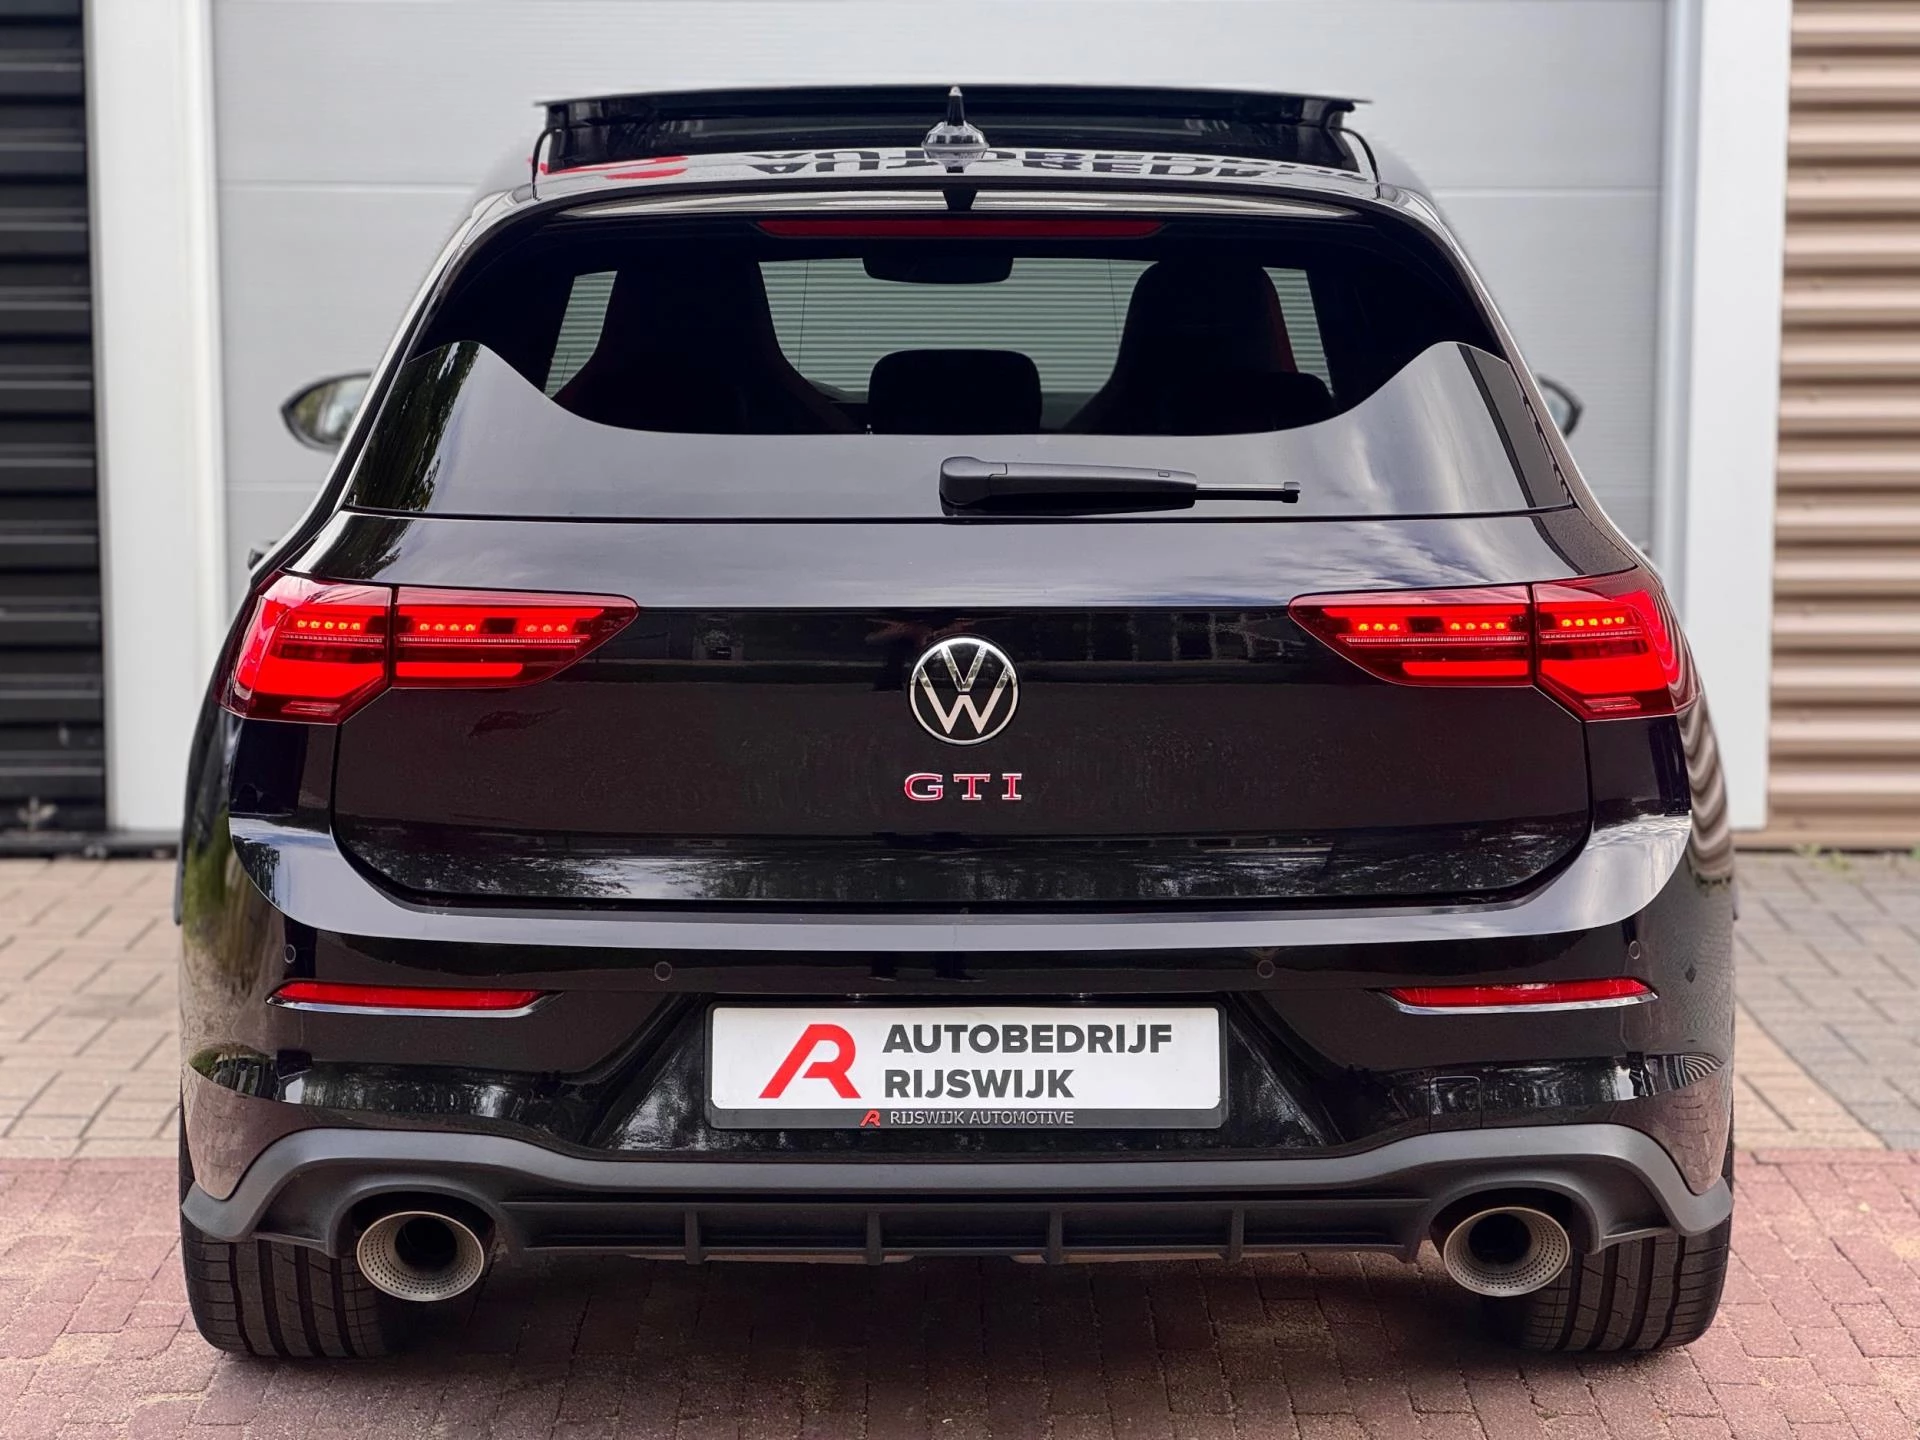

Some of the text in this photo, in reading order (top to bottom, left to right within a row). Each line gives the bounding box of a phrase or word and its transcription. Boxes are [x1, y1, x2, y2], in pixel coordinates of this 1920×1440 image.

[914, 642, 1013, 735] VW
[904, 772, 1023, 801] GTI
[882, 1023, 1172, 1054] AUTOBEDRIJF
[884, 1068, 1075, 1099] RIJSWIJK
[890, 1110, 965, 1126] RIJSWIJK
[969, 1110, 1074, 1125] AUTOMOTIVE
